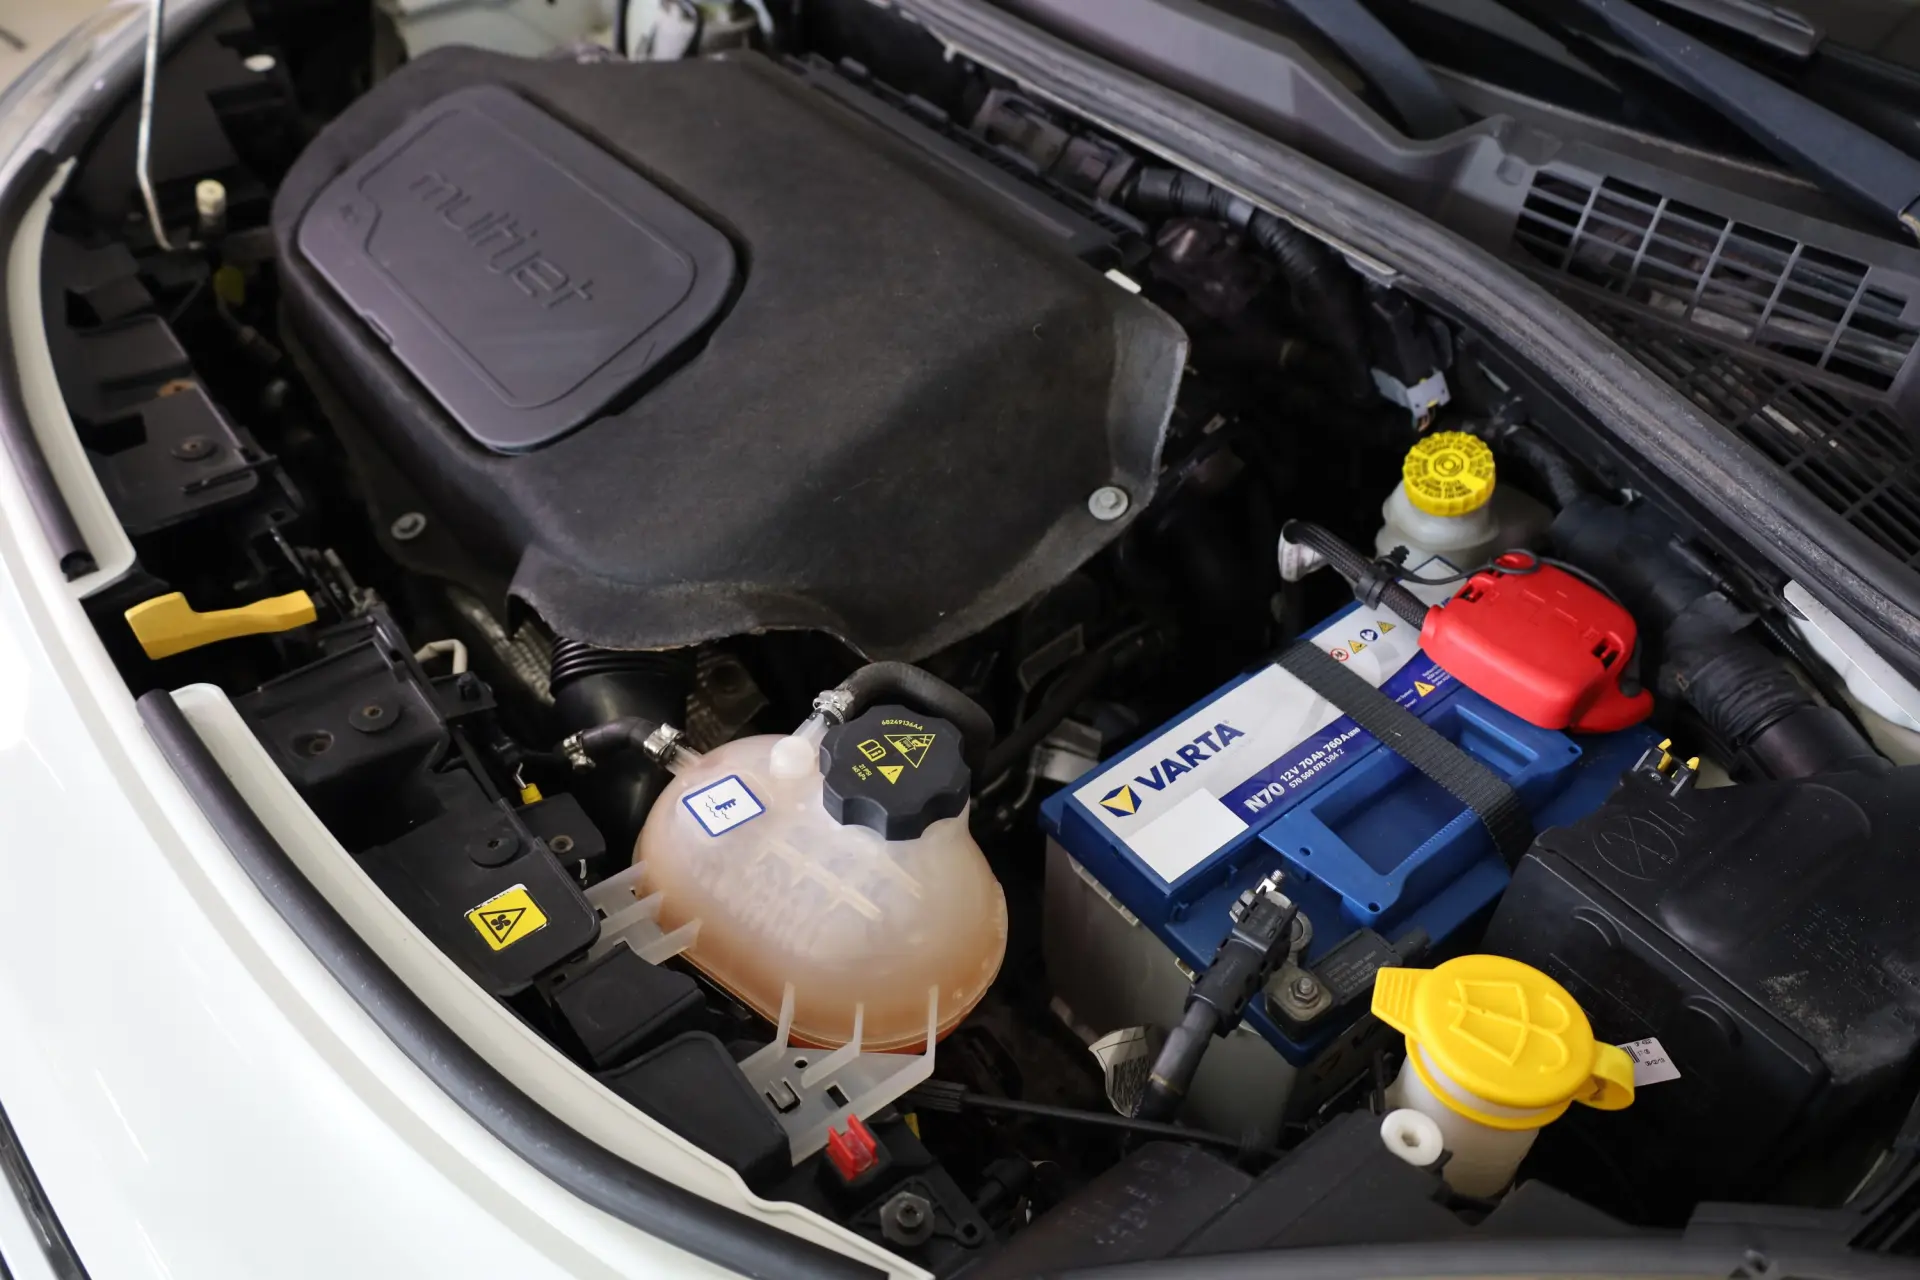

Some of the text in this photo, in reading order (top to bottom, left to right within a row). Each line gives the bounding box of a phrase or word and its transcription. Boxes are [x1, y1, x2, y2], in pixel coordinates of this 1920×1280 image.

[1134, 722, 1246, 792] VARTA
[1289, 778, 1302, 789] 570
[1301, 769, 1314, 780] 500
[1243, 782, 1286, 815] N70
[1280, 766, 1300, 783] 12V
